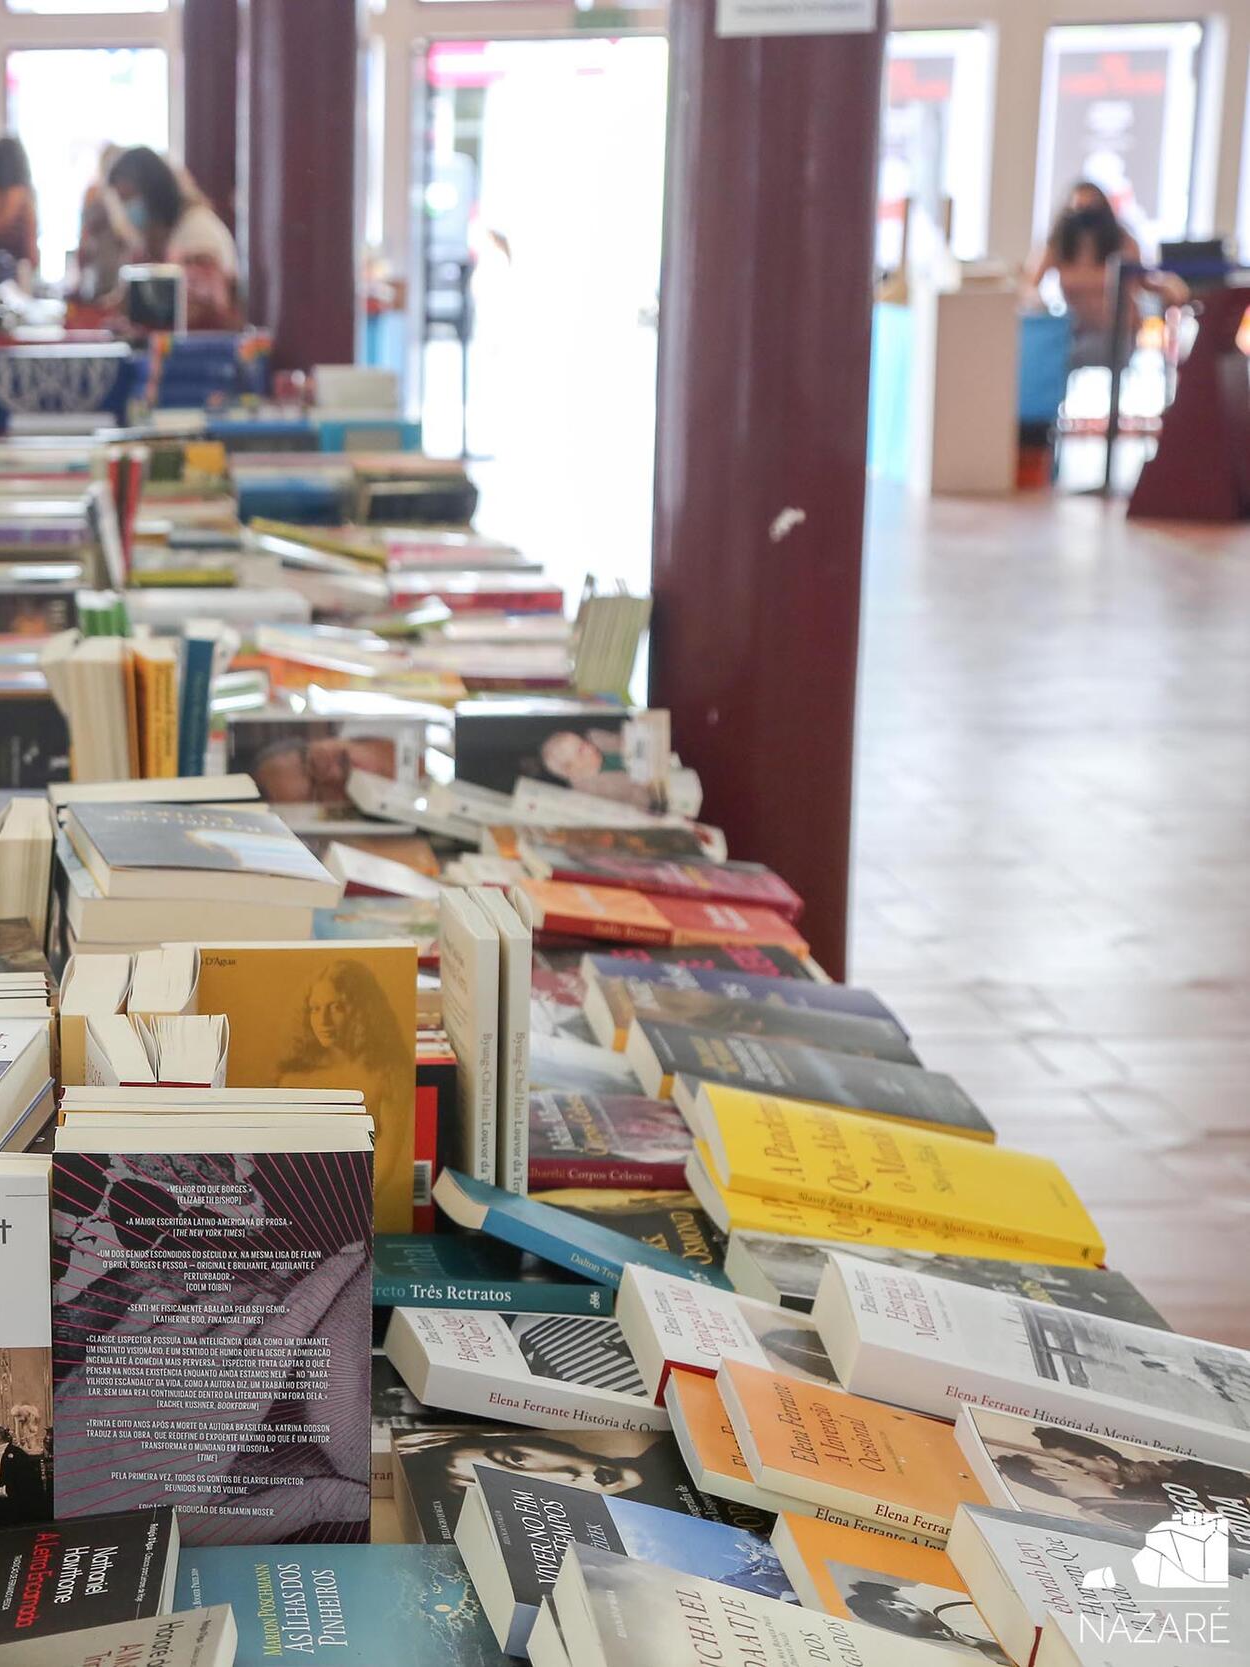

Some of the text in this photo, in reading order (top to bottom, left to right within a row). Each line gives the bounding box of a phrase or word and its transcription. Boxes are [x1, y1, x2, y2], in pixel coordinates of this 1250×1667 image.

[197, 1185, 206, 1194] DO
[207, 1185, 220, 1195] QUE
[134, 1217, 156, 1226] MAIOR
[156, 1217, 192, 1226] ESCRITORA
[256, 1218, 264, 1227] DE
[189, 1229, 204, 1238] NEW
[205, 1229, 222, 1238] YORK
[571, 1252, 600, 1273] Dalton
[204, 1304, 234, 1314] ABALADA
[235, 1304, 251, 1314] PELO
[251, 1305, 264, 1314] SEU
[409, 1284, 443, 1300] Três
[447, 1285, 512, 1302] Retratos
[207, 1315, 241, 1324] FINANCIAL
[489, 1391, 636, 1432] Elena Ferrante História de
[774, 1382, 820, 1466] Elena Ferrante
[809, 1402, 854, 1467] A Invenção
[945, 1384, 978, 1404] Elena
[980, 1394, 1031, 1418] Ferrante
[1033, 1407, 1082, 1432] História
[1084, 1420, 1100, 1435] da
[840, 1414, 886, 1472] Ocasional
[511, 1489, 559, 1584] VIVER NO FIM
[540, 1498, 576, 1552] TEMPOS
[815, 1507, 849, 1527] Elena
[874, 1504, 909, 1524] Elena
[85, 1546, 119, 1596] Nathaniel
[1045, 1537, 1079, 1562] Que
[14, 1532, 62, 1629] A Letra Encarnada
[54, 1546, 90, 1604] Hawthorne
[1016, 1538, 1074, 1615] eborah Levy
[254, 1563, 283, 1657] MARION POSCHMANN
[277, 1563, 315, 1655] AS ILHAS DOS
[311, 1569, 349, 1647] PINHEIROS
[676, 1590, 723, 1667] ICHAEL
[799, 1630, 831, 1662] DOS
